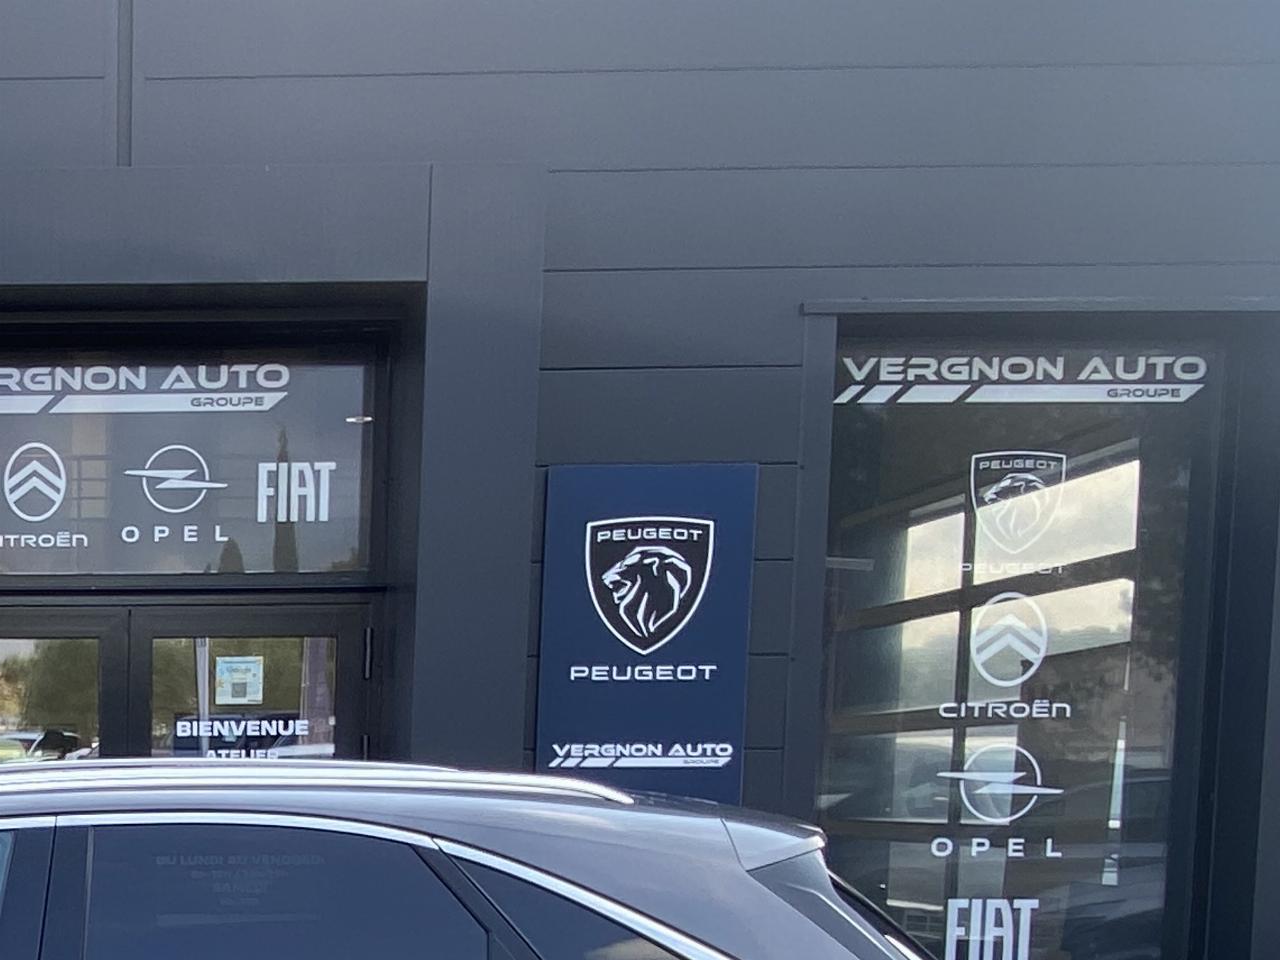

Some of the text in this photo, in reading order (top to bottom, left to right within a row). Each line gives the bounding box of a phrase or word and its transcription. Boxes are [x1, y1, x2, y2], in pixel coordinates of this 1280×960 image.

[161, 363, 290, 390] AUTO
[843, 356, 1207, 381] VERGNON AUTO
[1107, 388, 1181, 398] GROUPE
[190, 396, 265, 408] GROUPE
[979, 459, 1058, 470] PEUGEOT
[257, 462, 336, 522] FIAT
[121, 525, 228, 542] OPEL
[597, 528, 703, 543] PEUGEOT
[570, 665, 718, 681] PEUGEOT
[939, 700, 1071, 718] CITROËN
[176, 719, 309, 737] BIENVENUE
[552, 743, 733, 757] VERGNON AUTO
[931, 838, 1062, 857] OPEL
